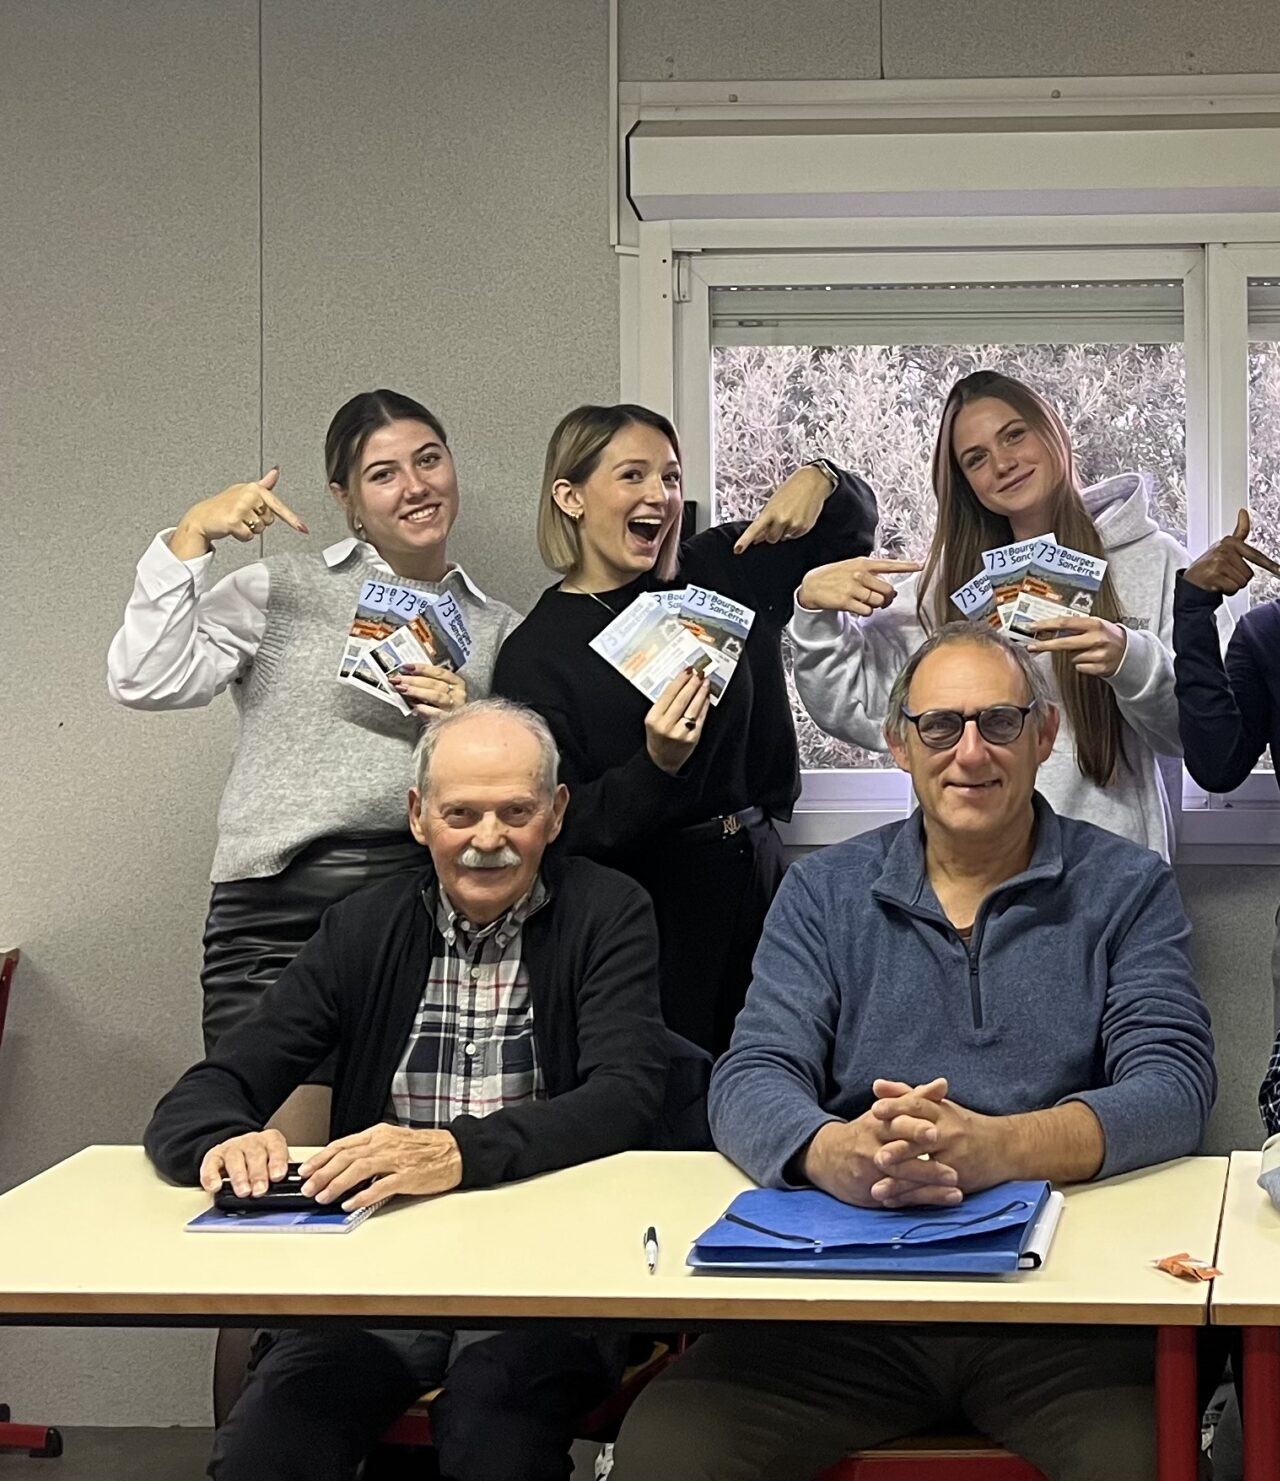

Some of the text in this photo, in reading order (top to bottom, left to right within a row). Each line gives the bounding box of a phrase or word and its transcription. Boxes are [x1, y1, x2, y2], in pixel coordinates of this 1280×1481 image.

[1060, 550, 1096, 568] Bourges
[711, 595, 745, 616] Bourges
[454, 614, 472, 646] Bourges
